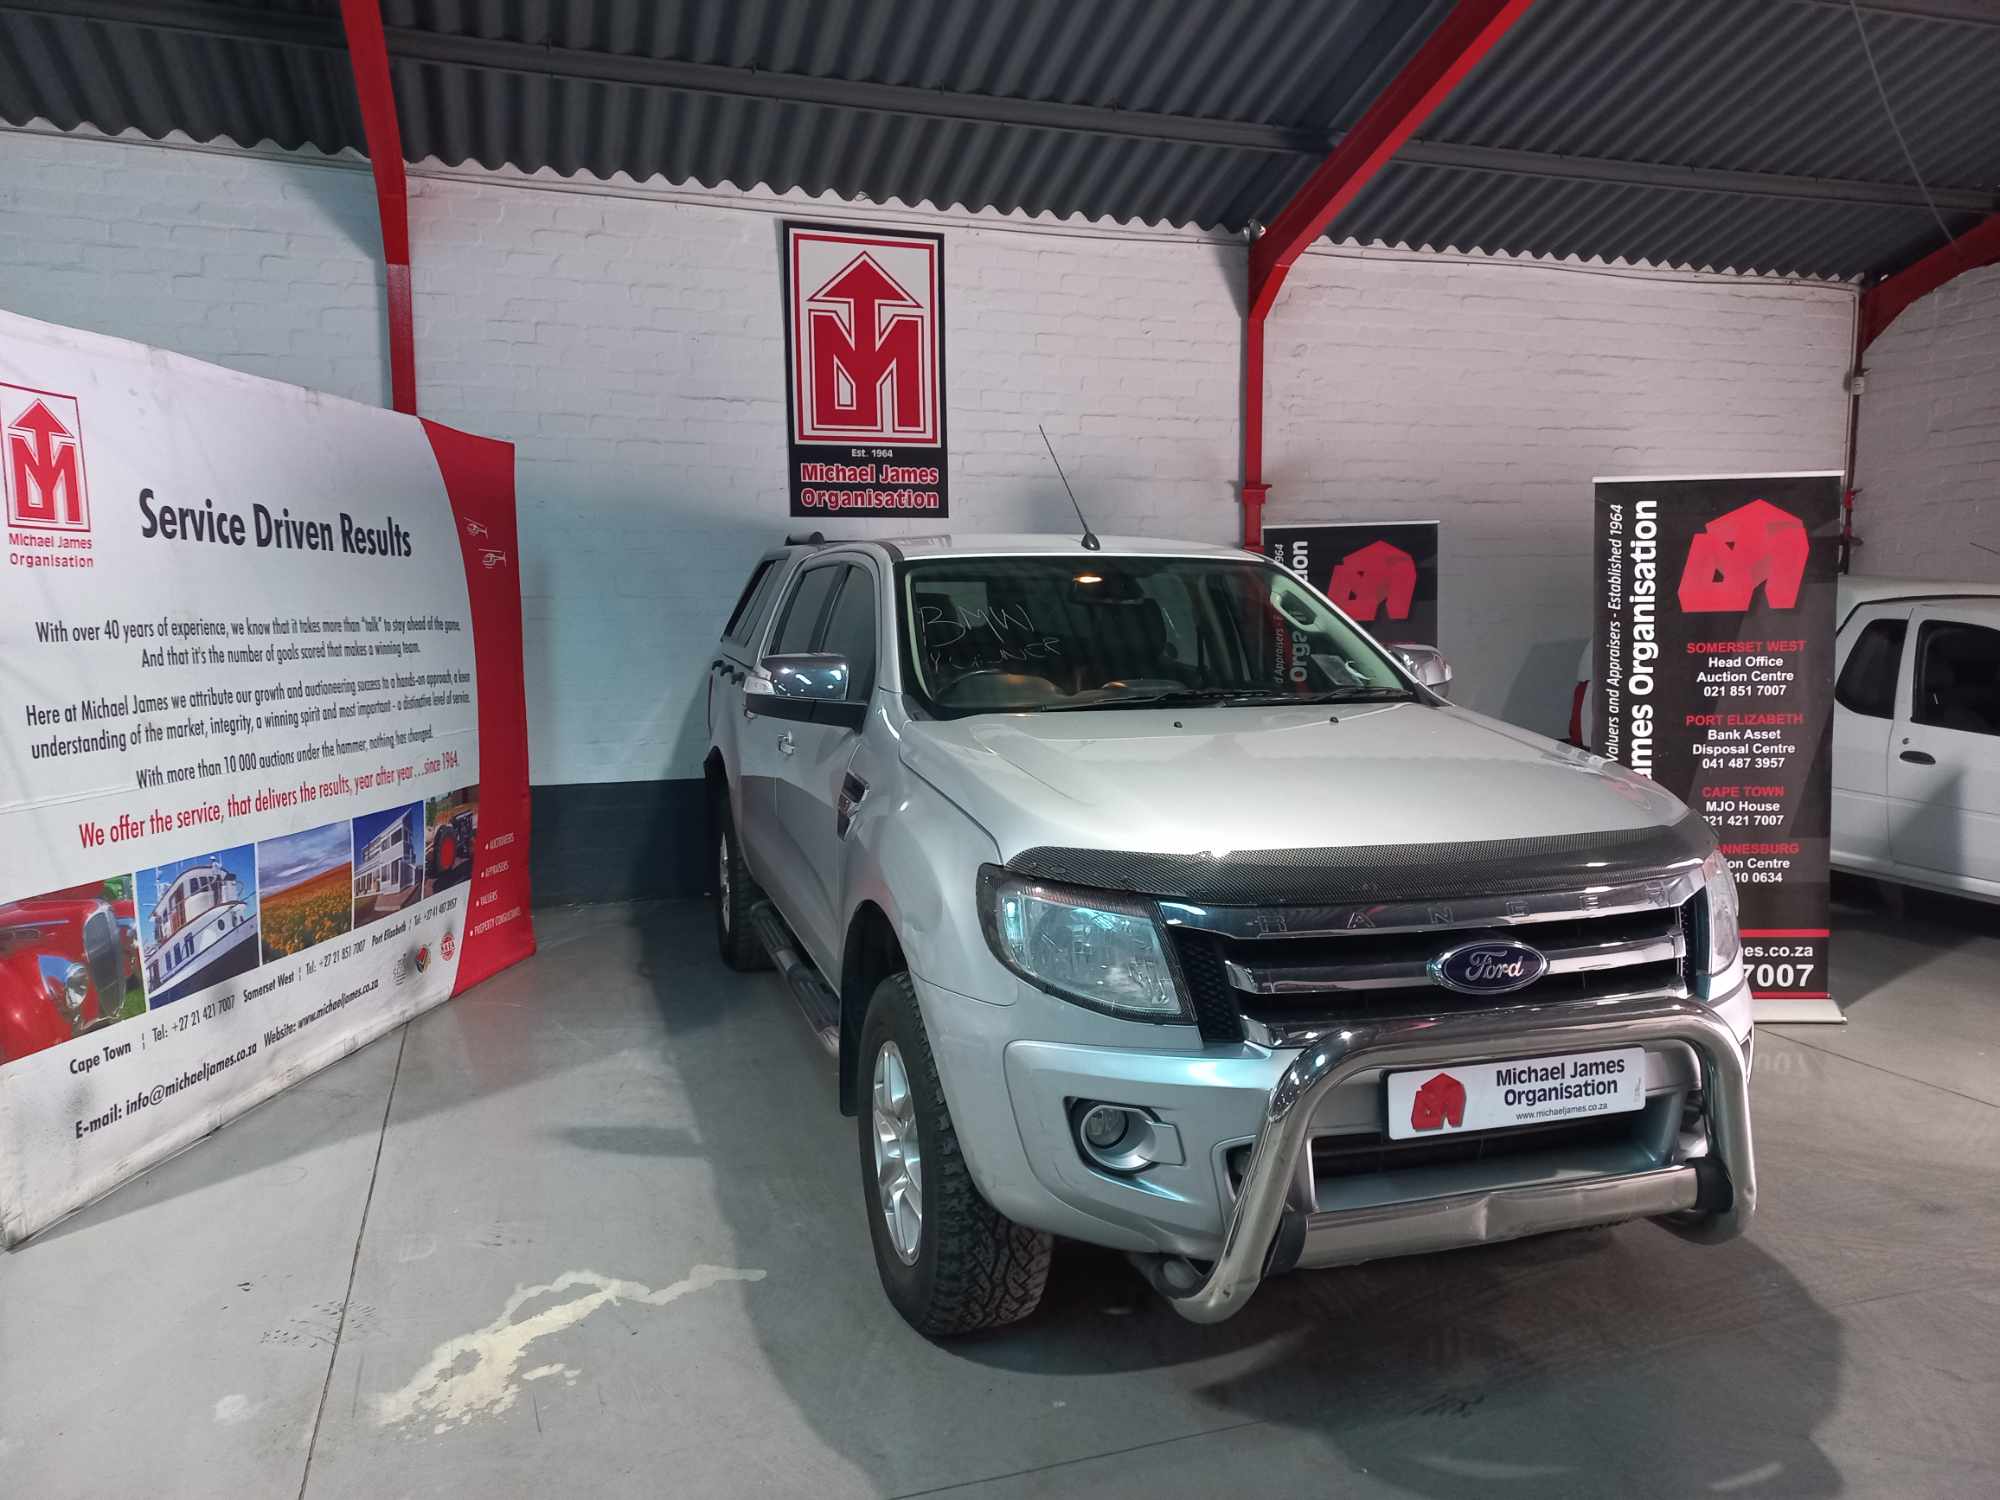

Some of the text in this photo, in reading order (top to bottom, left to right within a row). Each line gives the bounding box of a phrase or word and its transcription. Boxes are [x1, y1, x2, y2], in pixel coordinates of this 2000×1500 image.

[851, 448, 893, 459] Est. 1964
[801, 463, 939, 484] Michael James
[801, 488, 939, 509] Organisation
[139, 488, 412, 557] Service Driven Results
[1609, 504, 1623, 536] 1964
[8, 533, 92, 550] Michael James
[9, 552, 94, 569] Organisation
[1274, 543, 1284, 564] 964
[1607, 539, 1622, 610] Established
[1628, 500, 1659, 695] Organisation
[35, 620, 68, 643] With
[72, 626, 100, 641] over
[104, 619, 119, 640] 40
[122, 622, 154, 643] years
[157, 616, 169, 636] of
[171, 618, 229, 640] experience,
[230, 623, 244, 636] we
[247, 617, 270, 636] know
[273, 617, 290, 635] that
[291, 617, 298, 634] it
[300, 617, 321, 634] takes
[918, 603, 1035, 648] BMW
[142, 647, 164, 667] And
[167, 646, 189, 666] that
[208, 645, 225, 664] the
[227, 645, 263, 663] number
[266, 644, 275, 662] of
[276, 643, 299, 664] goals
[301, 642, 326, 659] scored
[327, 641, 342, 658] that
[344, 640, 367, 657] makes
[369, 645, 374, 655] a
[1606, 621, 1623, 687] Appraisers
[1686, 640, 1806, 654] SOMERSET WEST
[1708, 656, 1784, 668] Head Office
[1696, 671, 1794, 682] Auction Centre
[26, 704, 60, 726] Here
[64, 704, 77, 722] at
[81, 695, 129, 721] Michael
[132, 695, 168, 714] James
[171, 695, 187, 709] we
[189, 687, 234, 707] attribute
[236, 690, 252, 704] our
[254, 683, 285, 705] growth
[287, 681, 302, 699] and
[305, 677, 355, 698] auctioneering
[1605, 689, 1620, 714] and
[1703, 685, 1787, 697] 021 851 7007
[31, 729, 127, 759] understanding
[130, 723, 142, 745] of
[145, 722, 164, 742] the
[166, 717, 208, 740] market,
[211, 714, 255, 736] integrity,
[256, 717, 262, 729] a
[264, 711, 299, 730] winning
[300, 706, 321, 727] spirit
[322, 702, 338, 721] and
[339, 703, 356, 717] most
[1685, 713, 1804, 726] PORT ELIZABETH
[1707, 729, 1781, 740] Bank Asset
[1692, 743, 1796, 756] Disposal Centre
[136, 765, 164, 789] With
[167, 766, 195, 783] more
[197, 758, 222, 778] than
[224, 755, 237, 773] 10
[239, 752, 257, 772] 000
[258, 750, 295, 768] auctions
[297, 744, 320, 762] under
[322, 740, 335, 757] the
[1702, 757, 1785, 769] 041 487 3957
[1702, 785, 1785, 798] CAPE TOWN
[79, 821, 105, 848] We
[110, 814, 145, 843] offer
[149, 809, 173, 834] the
[177, 801, 224, 829] service,
[228, 794, 251, 818] that
[255, 787, 297, 812] delivers
[300, 782, 317, 802] the
[319, 774, 353, 799] results,
[354, 773, 374, 795] year
[375, 766, 396, 787] after
[1705, 801, 1780, 812] MJO House
[1727, 815, 1749, 826] 421
[1753, 815, 1784, 825] 7007
[1747, 858, 1791, 868] Centre
[1752, 872, 1783, 883] 0634
[243, 982, 276, 1003] Somerset
[278, 970, 295, 988] West
[305, 960, 317, 976] Tel:
[333, 950, 340, 964] 21
[1465, 950, 1524, 981] Ford
[263, 978, 379, 1048] Website: www.michaeljames.co.za
[69, 995, 236, 1075] Cape Town Tel: +27 21 421 7007
[1496, 1059, 1625, 1086] Michael James
[75, 1042, 257, 1139] E-mail: info@michaeljames.co.za
[1504, 1079, 1618, 1106] Organisation
[1515, 1102, 1608, 1120] www.michaeljames.co.za
